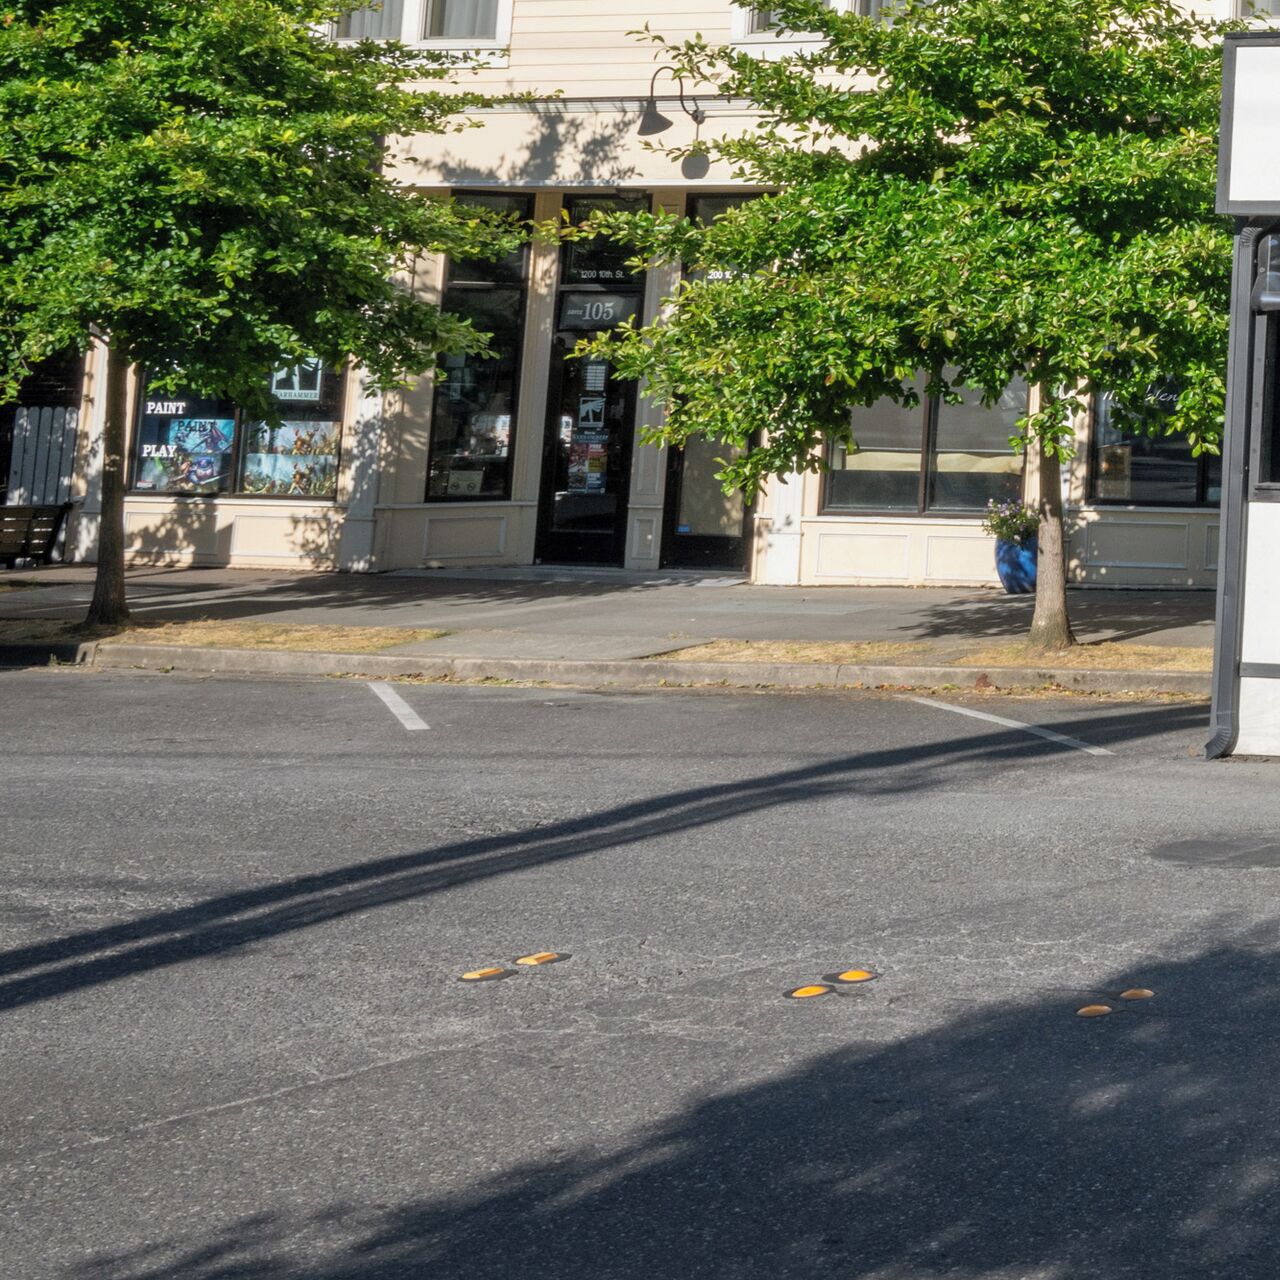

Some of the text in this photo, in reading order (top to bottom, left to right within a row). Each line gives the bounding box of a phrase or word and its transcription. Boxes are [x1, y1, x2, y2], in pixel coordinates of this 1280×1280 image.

[582, 302, 614, 320] 105
[146, 402, 186, 414] PAINT
[142, 445, 177, 457] PLAY
